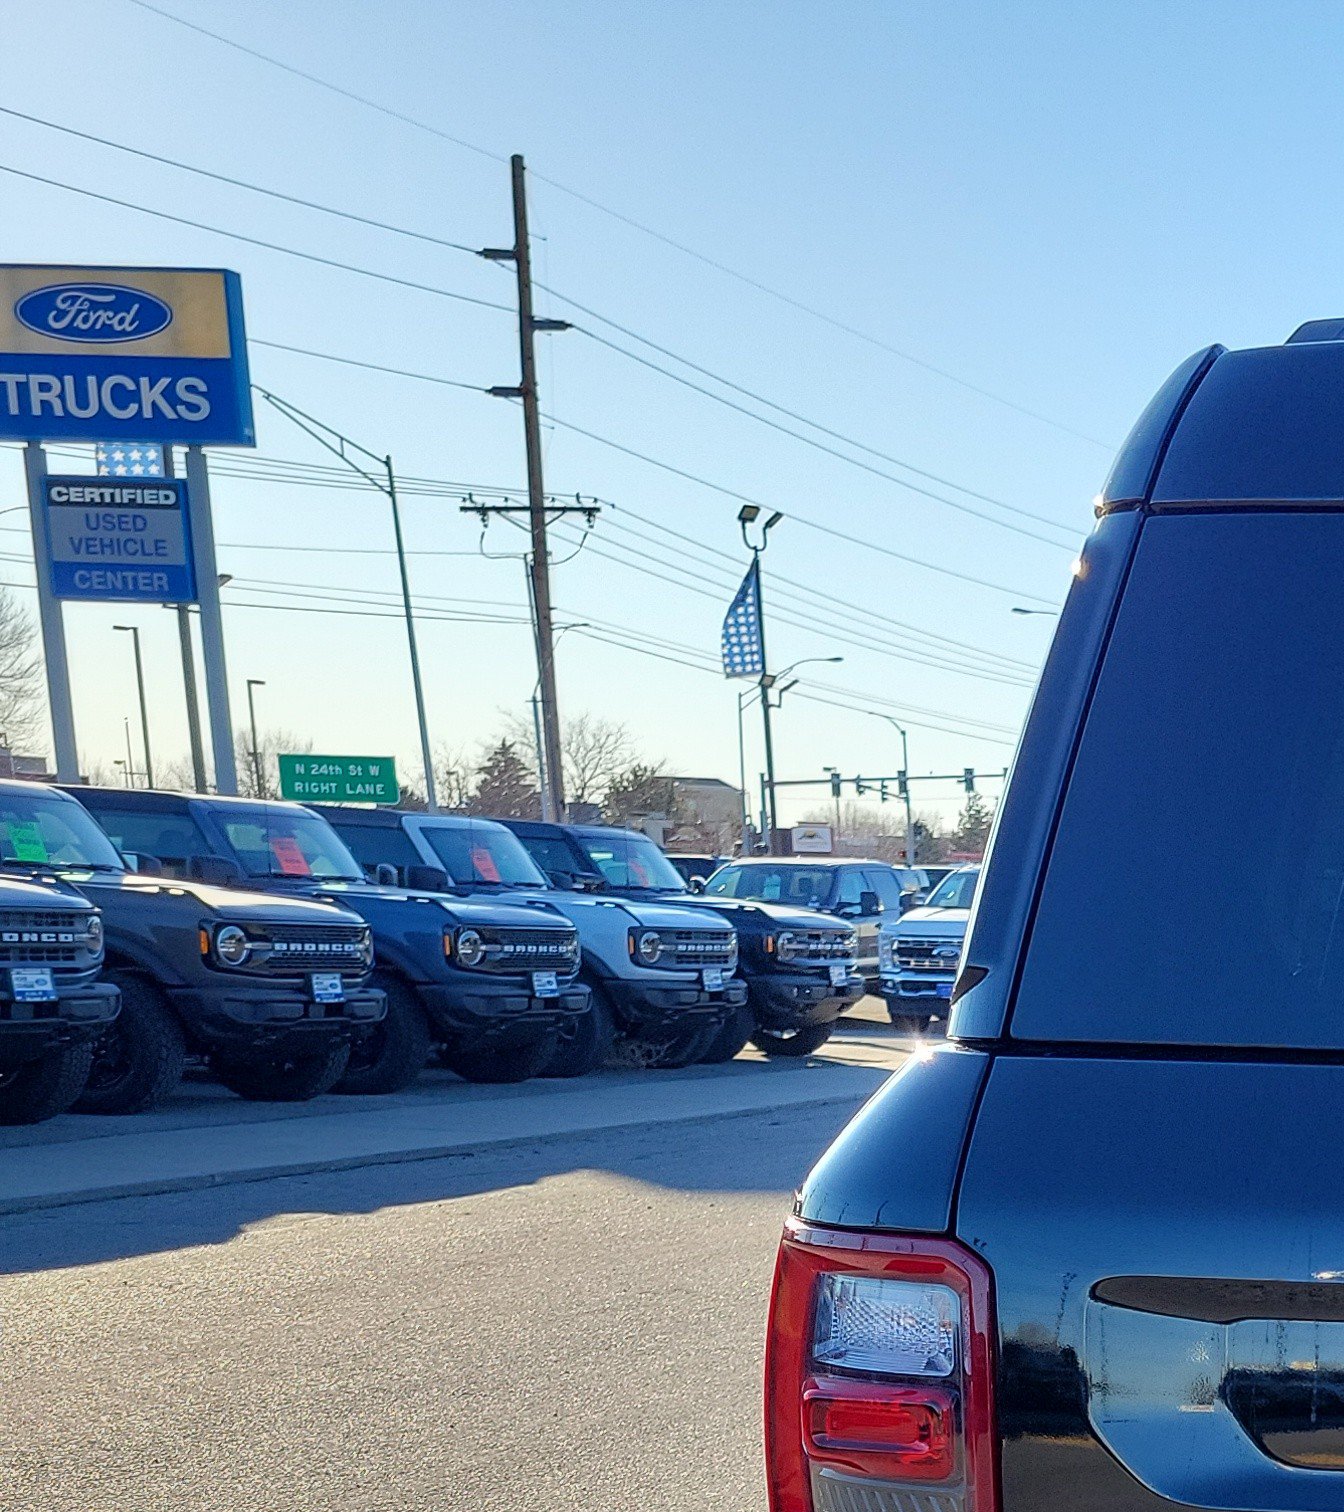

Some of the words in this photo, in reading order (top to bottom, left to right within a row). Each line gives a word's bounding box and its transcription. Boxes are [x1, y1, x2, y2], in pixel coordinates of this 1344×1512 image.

[48, 290, 140, 332] Ford
[0, 373, 211, 422] TRUCKS
[50, 486, 177, 506] CERTIFIED
[84, 512, 148, 533] USED
[68, 536, 168, 558] VEHICLE
[73, 569, 170, 592] CENTER
[294, 763, 305, 775] N
[310, 763, 343, 775] 24th
[348, 764, 363, 776] St
[368, 765, 380, 777] W
[294, 781, 338, 794] RIGHT
[345, 783, 386, 795] LANE
[274, 942, 355, 952] BRONCO
